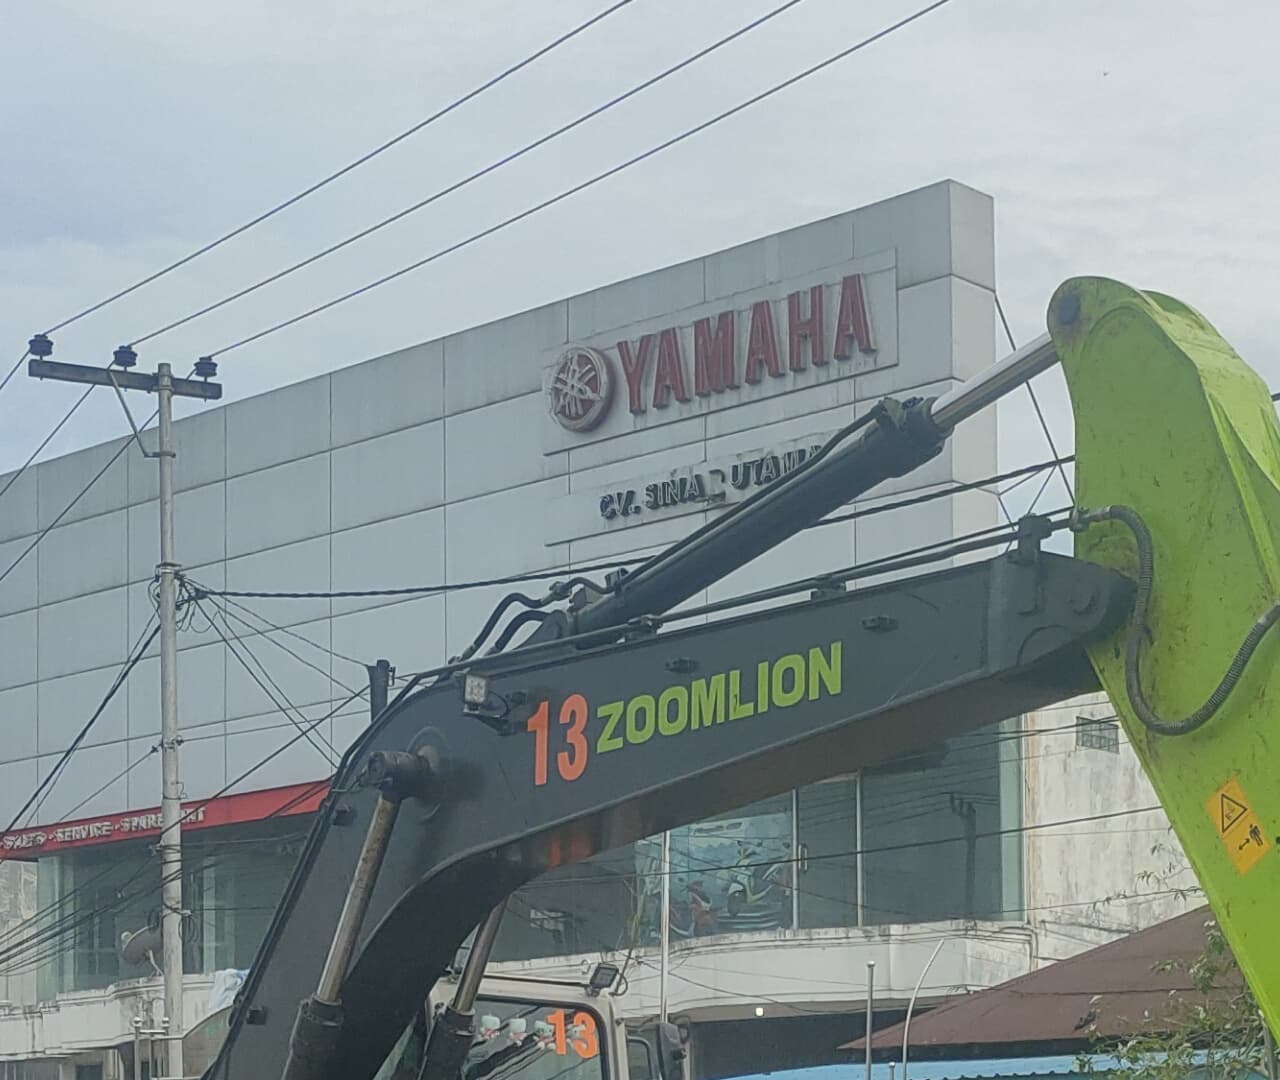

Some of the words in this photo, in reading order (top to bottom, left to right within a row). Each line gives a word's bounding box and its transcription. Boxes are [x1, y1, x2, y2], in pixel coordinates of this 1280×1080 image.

[617, 273, 877, 415] YAMAHA
[527, 693, 589, 786] 13
[596, 641, 842, 754] ZOOMLION
[55, 821, 113, 843] SERVICE
[547, 1008, 596, 1059] 13
